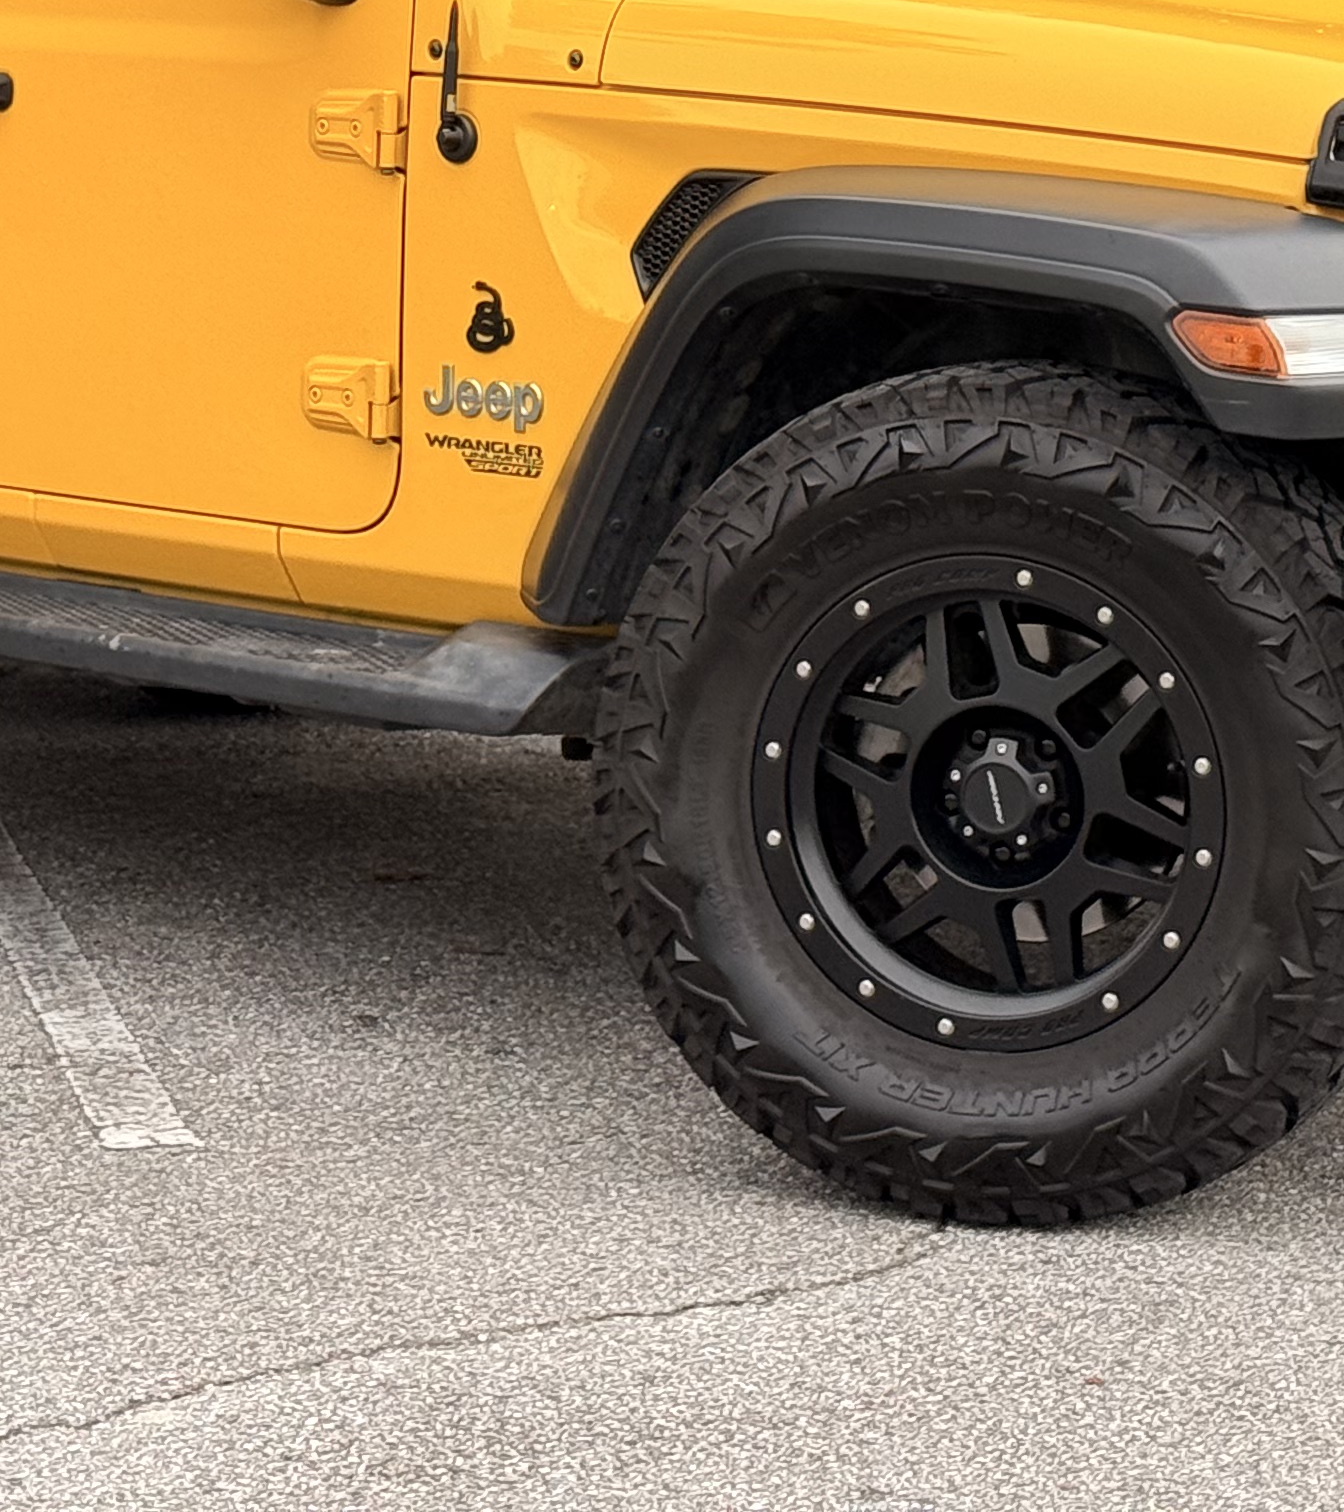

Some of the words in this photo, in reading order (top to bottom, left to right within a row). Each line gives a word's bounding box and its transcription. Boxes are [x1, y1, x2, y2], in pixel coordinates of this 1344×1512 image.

[423, 365, 544, 433] Jeep
[425, 432, 543, 458] WRANGLER
[468, 460, 541, 477] SPORT
[961, 489, 1134, 572] POWER
[878, 1073, 1094, 1117] HUNTER
